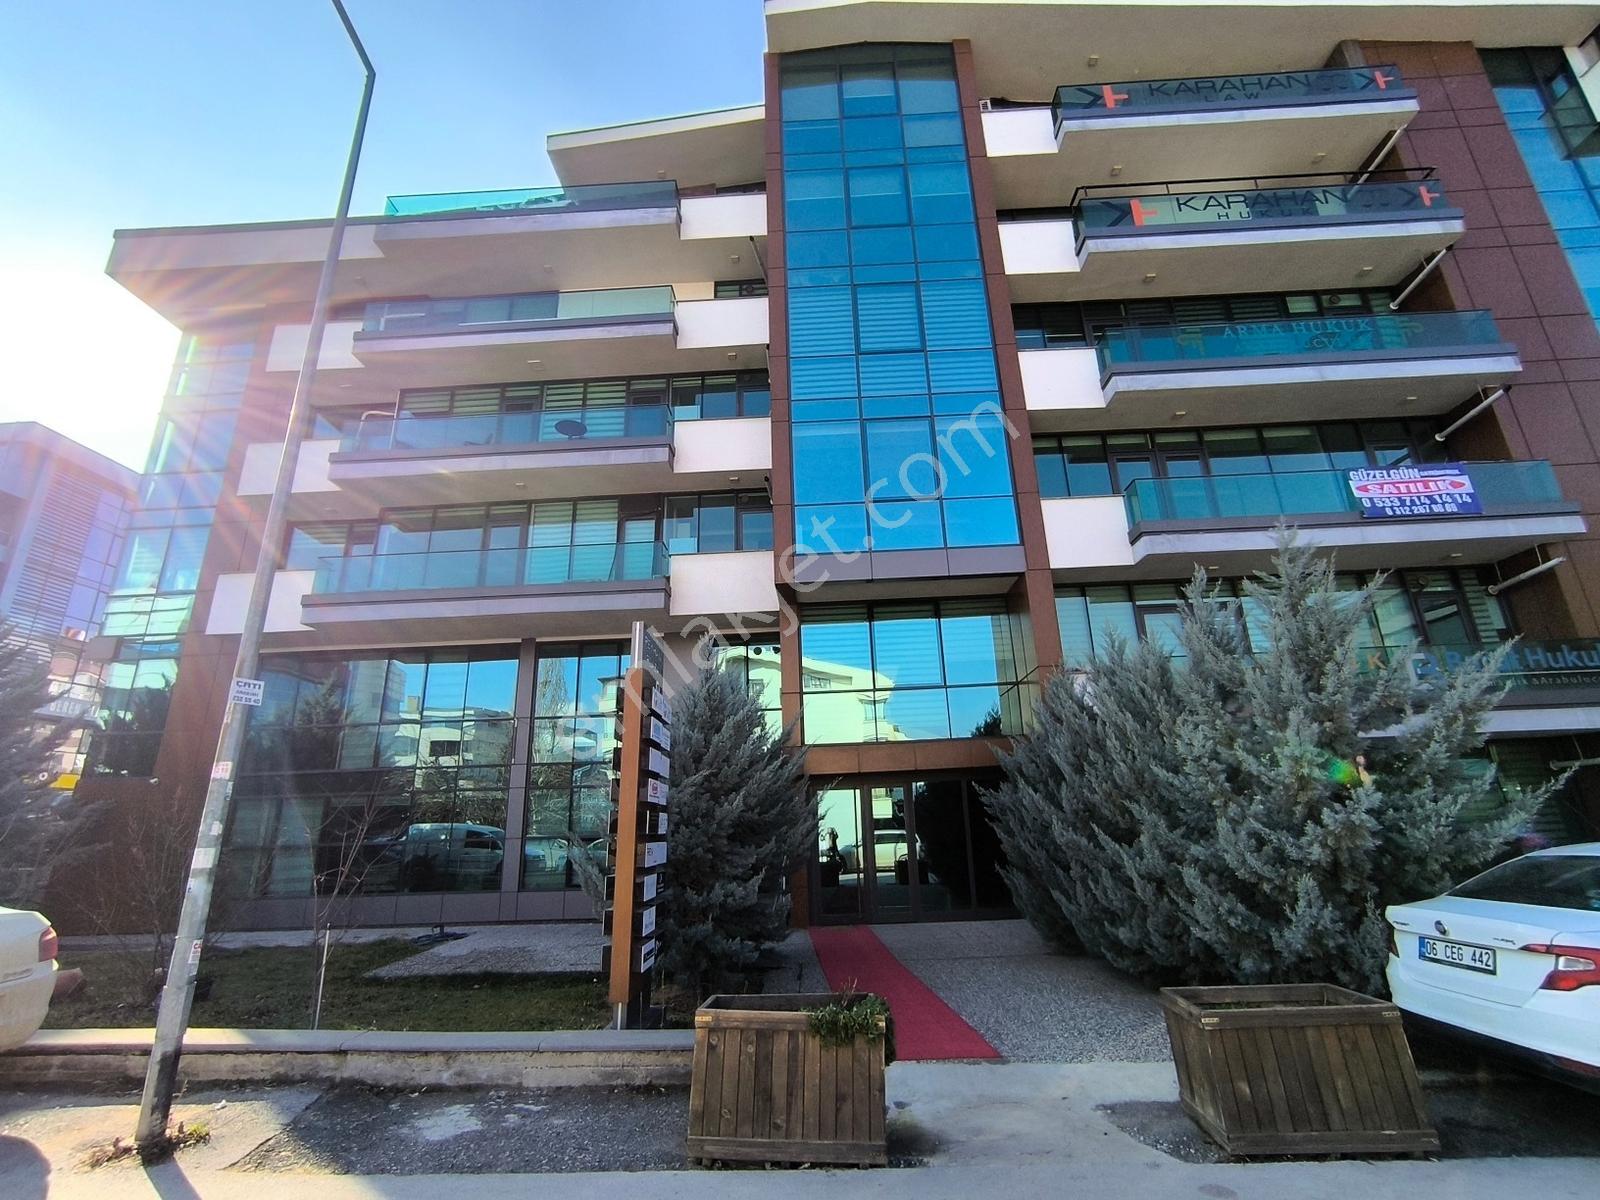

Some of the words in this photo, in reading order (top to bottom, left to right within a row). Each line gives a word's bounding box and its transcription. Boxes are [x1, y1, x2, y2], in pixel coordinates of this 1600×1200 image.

[1149, 74, 1311, 97] KARAHAN
[1204, 92, 1259, 103] LAW
[1175, 189, 1348, 212] KARAHAN
[1217, 207, 1314, 220] HUKUK
[1223, 325, 1282, 339] ARMA
[1292, 318, 1374, 334] HUKUK
[1349, 467, 1421, 481] GÜZELGÜN
[1366, 479, 1452, 494] SATILIK
[1362, 497, 1371, 507] 0
[1374, 497, 1400, 507] 533
[1402, 495, 1431, 506] 714
[1433, 494, 1452, 503] 14
[1454, 493, 1472, 503] 14
[1425, 941, 1438, 957] 06
[1444, 945, 1463, 961] CEG
[1471, 949, 1491, 967] 442
